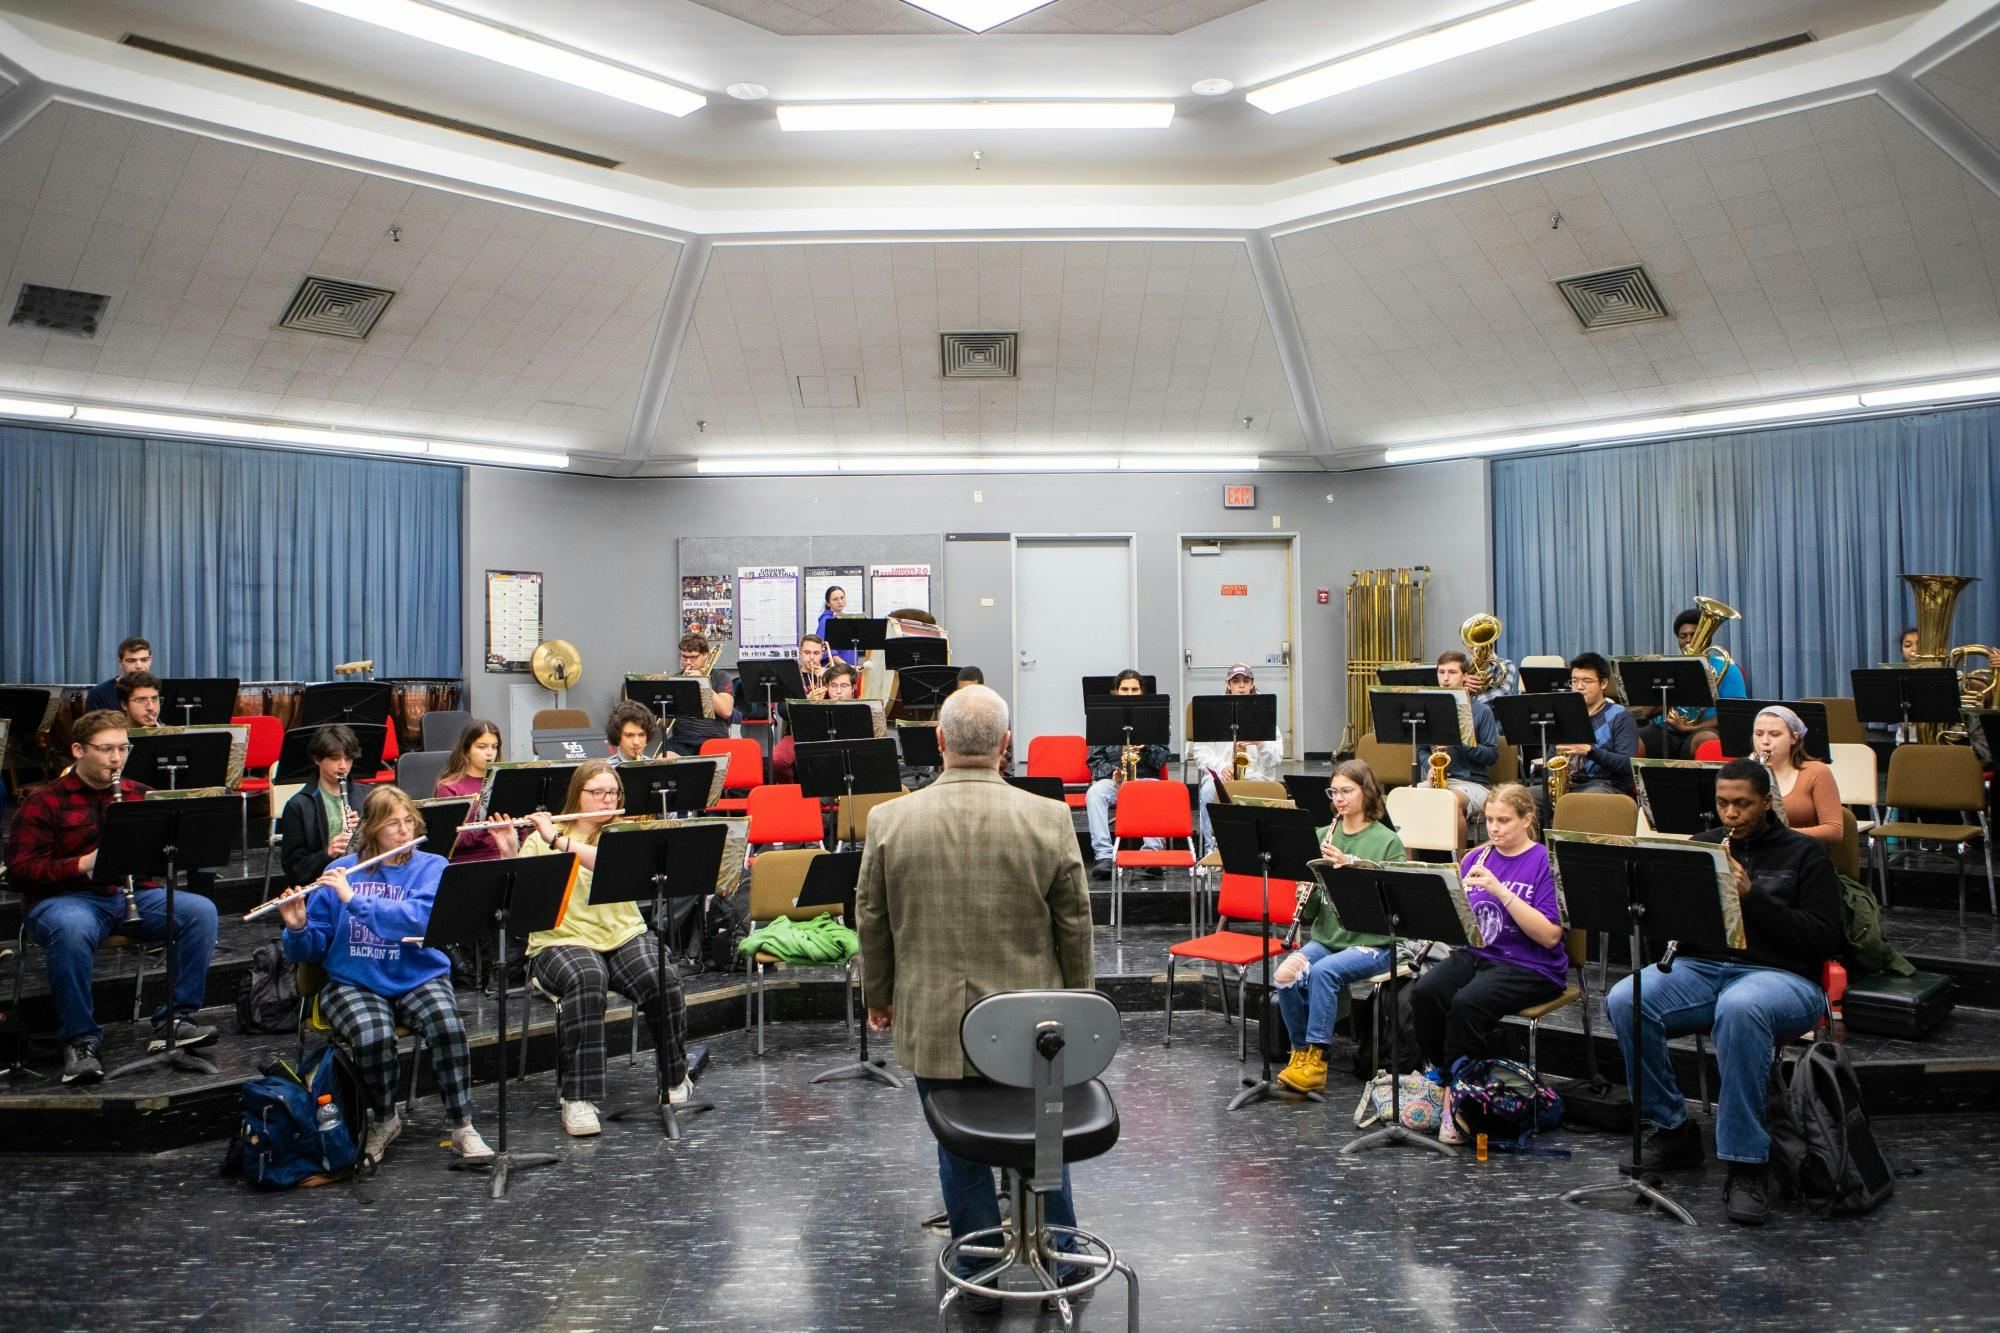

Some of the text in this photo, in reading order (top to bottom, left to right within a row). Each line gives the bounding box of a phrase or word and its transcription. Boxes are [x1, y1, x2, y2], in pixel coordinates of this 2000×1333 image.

[1228, 487, 1250, 505] EXIT
[350, 946, 374, 958] BACK
[374, 948, 386, 960] ON
